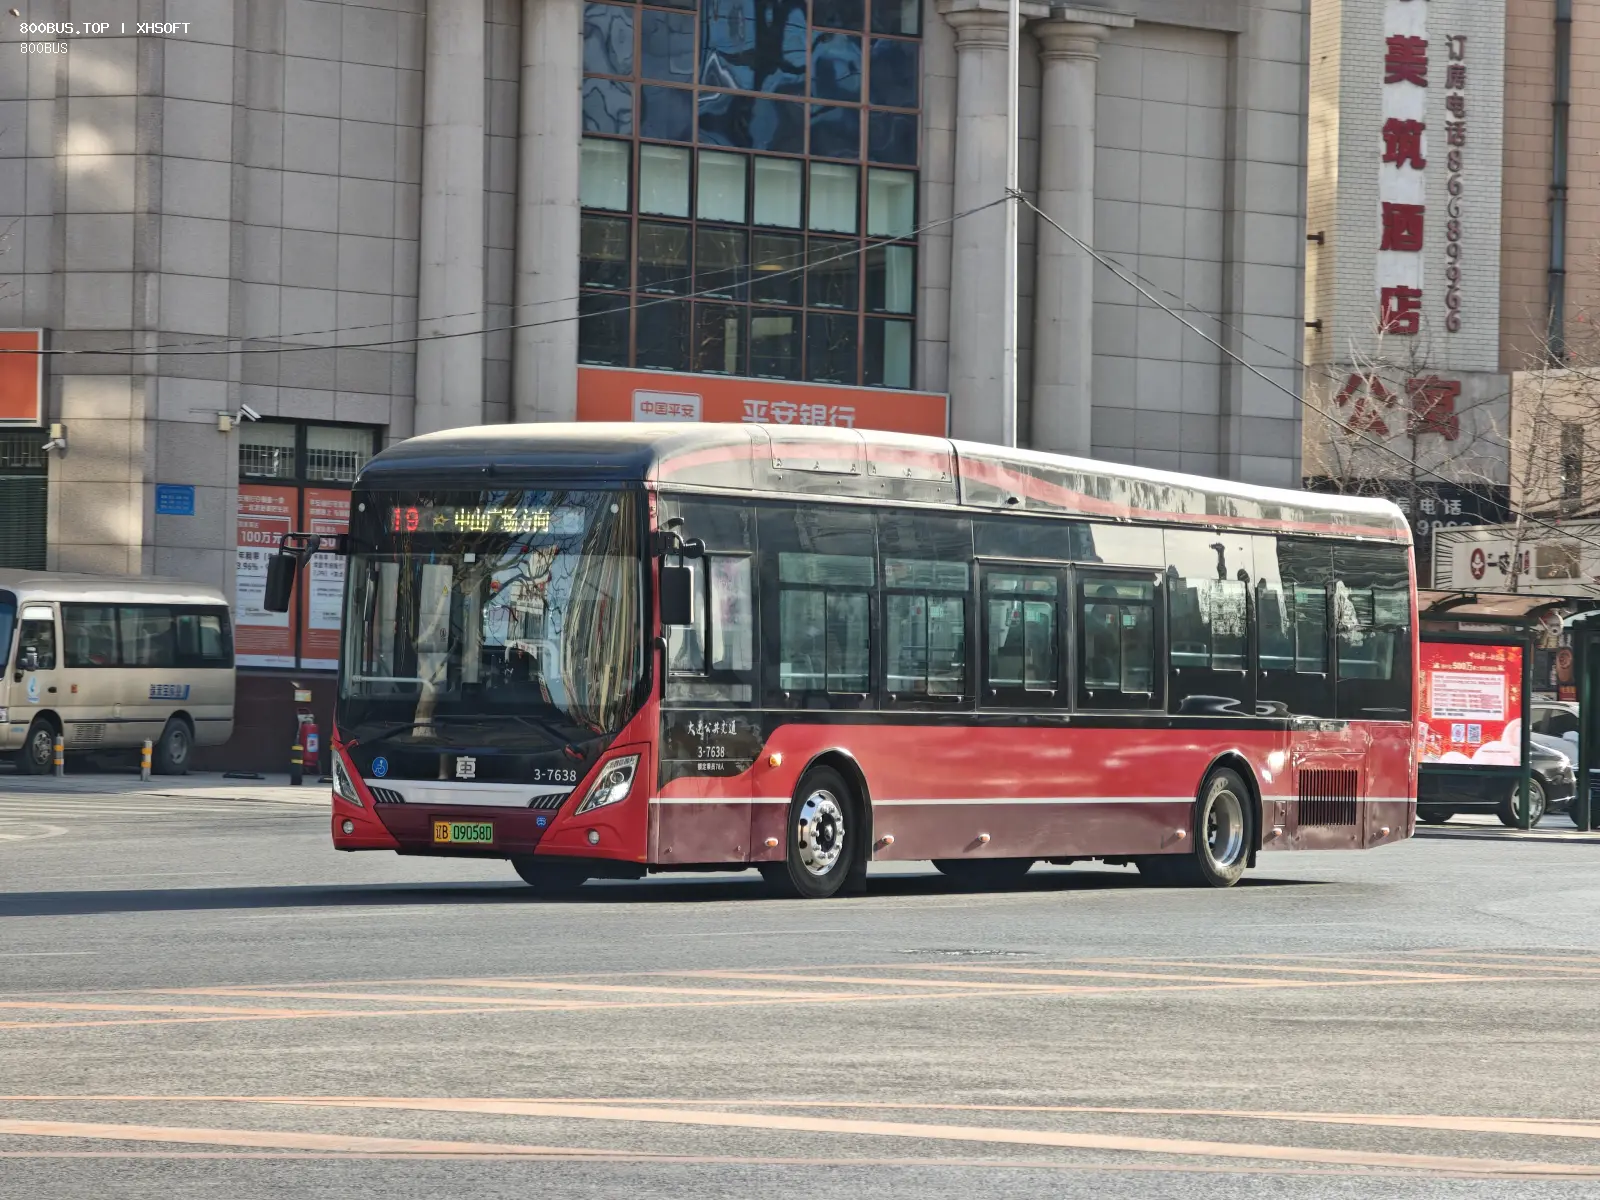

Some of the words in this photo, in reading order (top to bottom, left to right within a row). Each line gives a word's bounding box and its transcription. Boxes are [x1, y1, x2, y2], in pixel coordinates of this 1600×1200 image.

[1378, 0, 1430, 335] 美筑酒店
[639, 400, 695, 418] 中国平安
[742, 399, 856, 429] 平安银行
[1333, 373, 1461, 441] 公寓
[392, 507, 420, 532] 19
[454, 507, 551, 533] 中山广场方向
[697, 746, 725, 758] 3-7638
[533, 768, 577, 783] 3-7638
